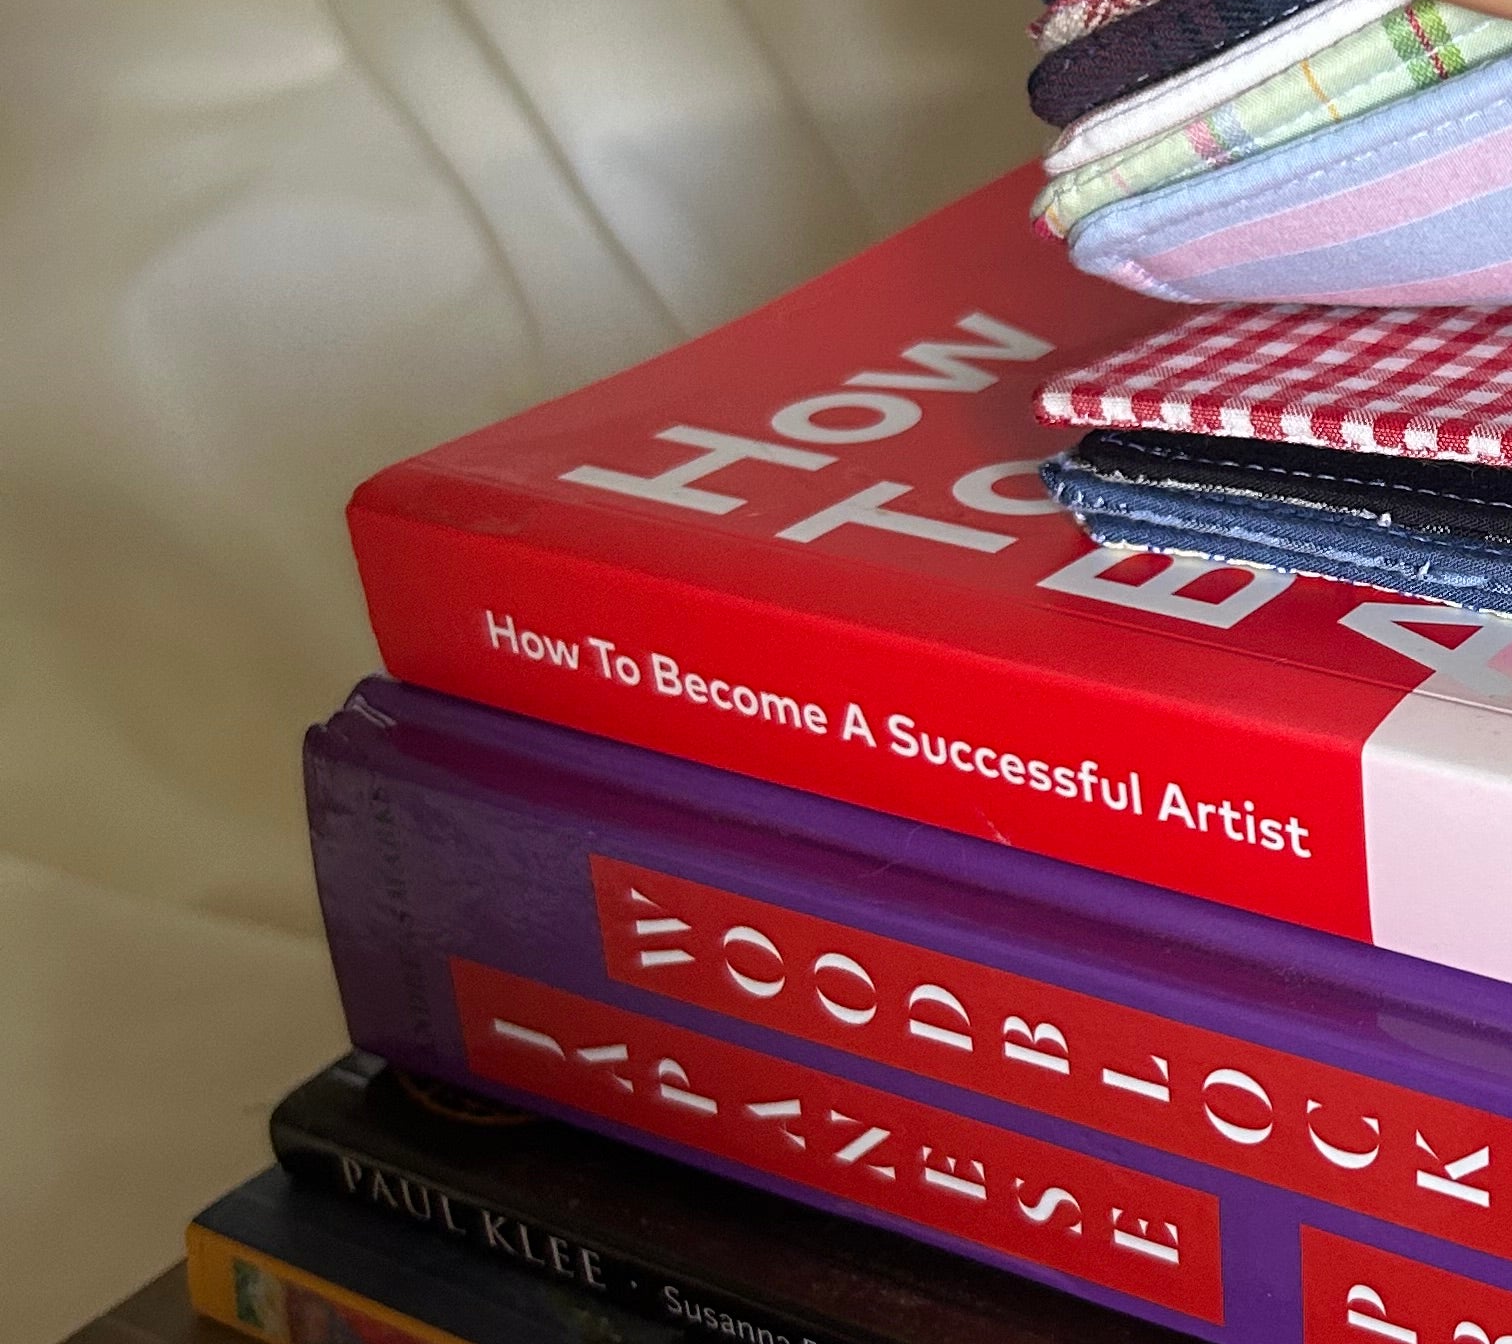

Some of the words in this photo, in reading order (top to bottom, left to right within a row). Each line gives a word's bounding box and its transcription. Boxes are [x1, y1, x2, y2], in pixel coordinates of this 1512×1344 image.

[558, 311, 1056, 515] How
[484, 609, 579, 670] How
[588, 636, 640, 688] To
[650, 652, 828, 735] Become
[841, 702, 877, 749] A
[888, 714, 1143, 816] Successful
[1157, 782, 1313, 858] Artist
[342, 1157, 466, 1235] PAUL
[483, 1214, 607, 1291] KLEE
[494, 1018, 1180, 1265] JAPANESE
